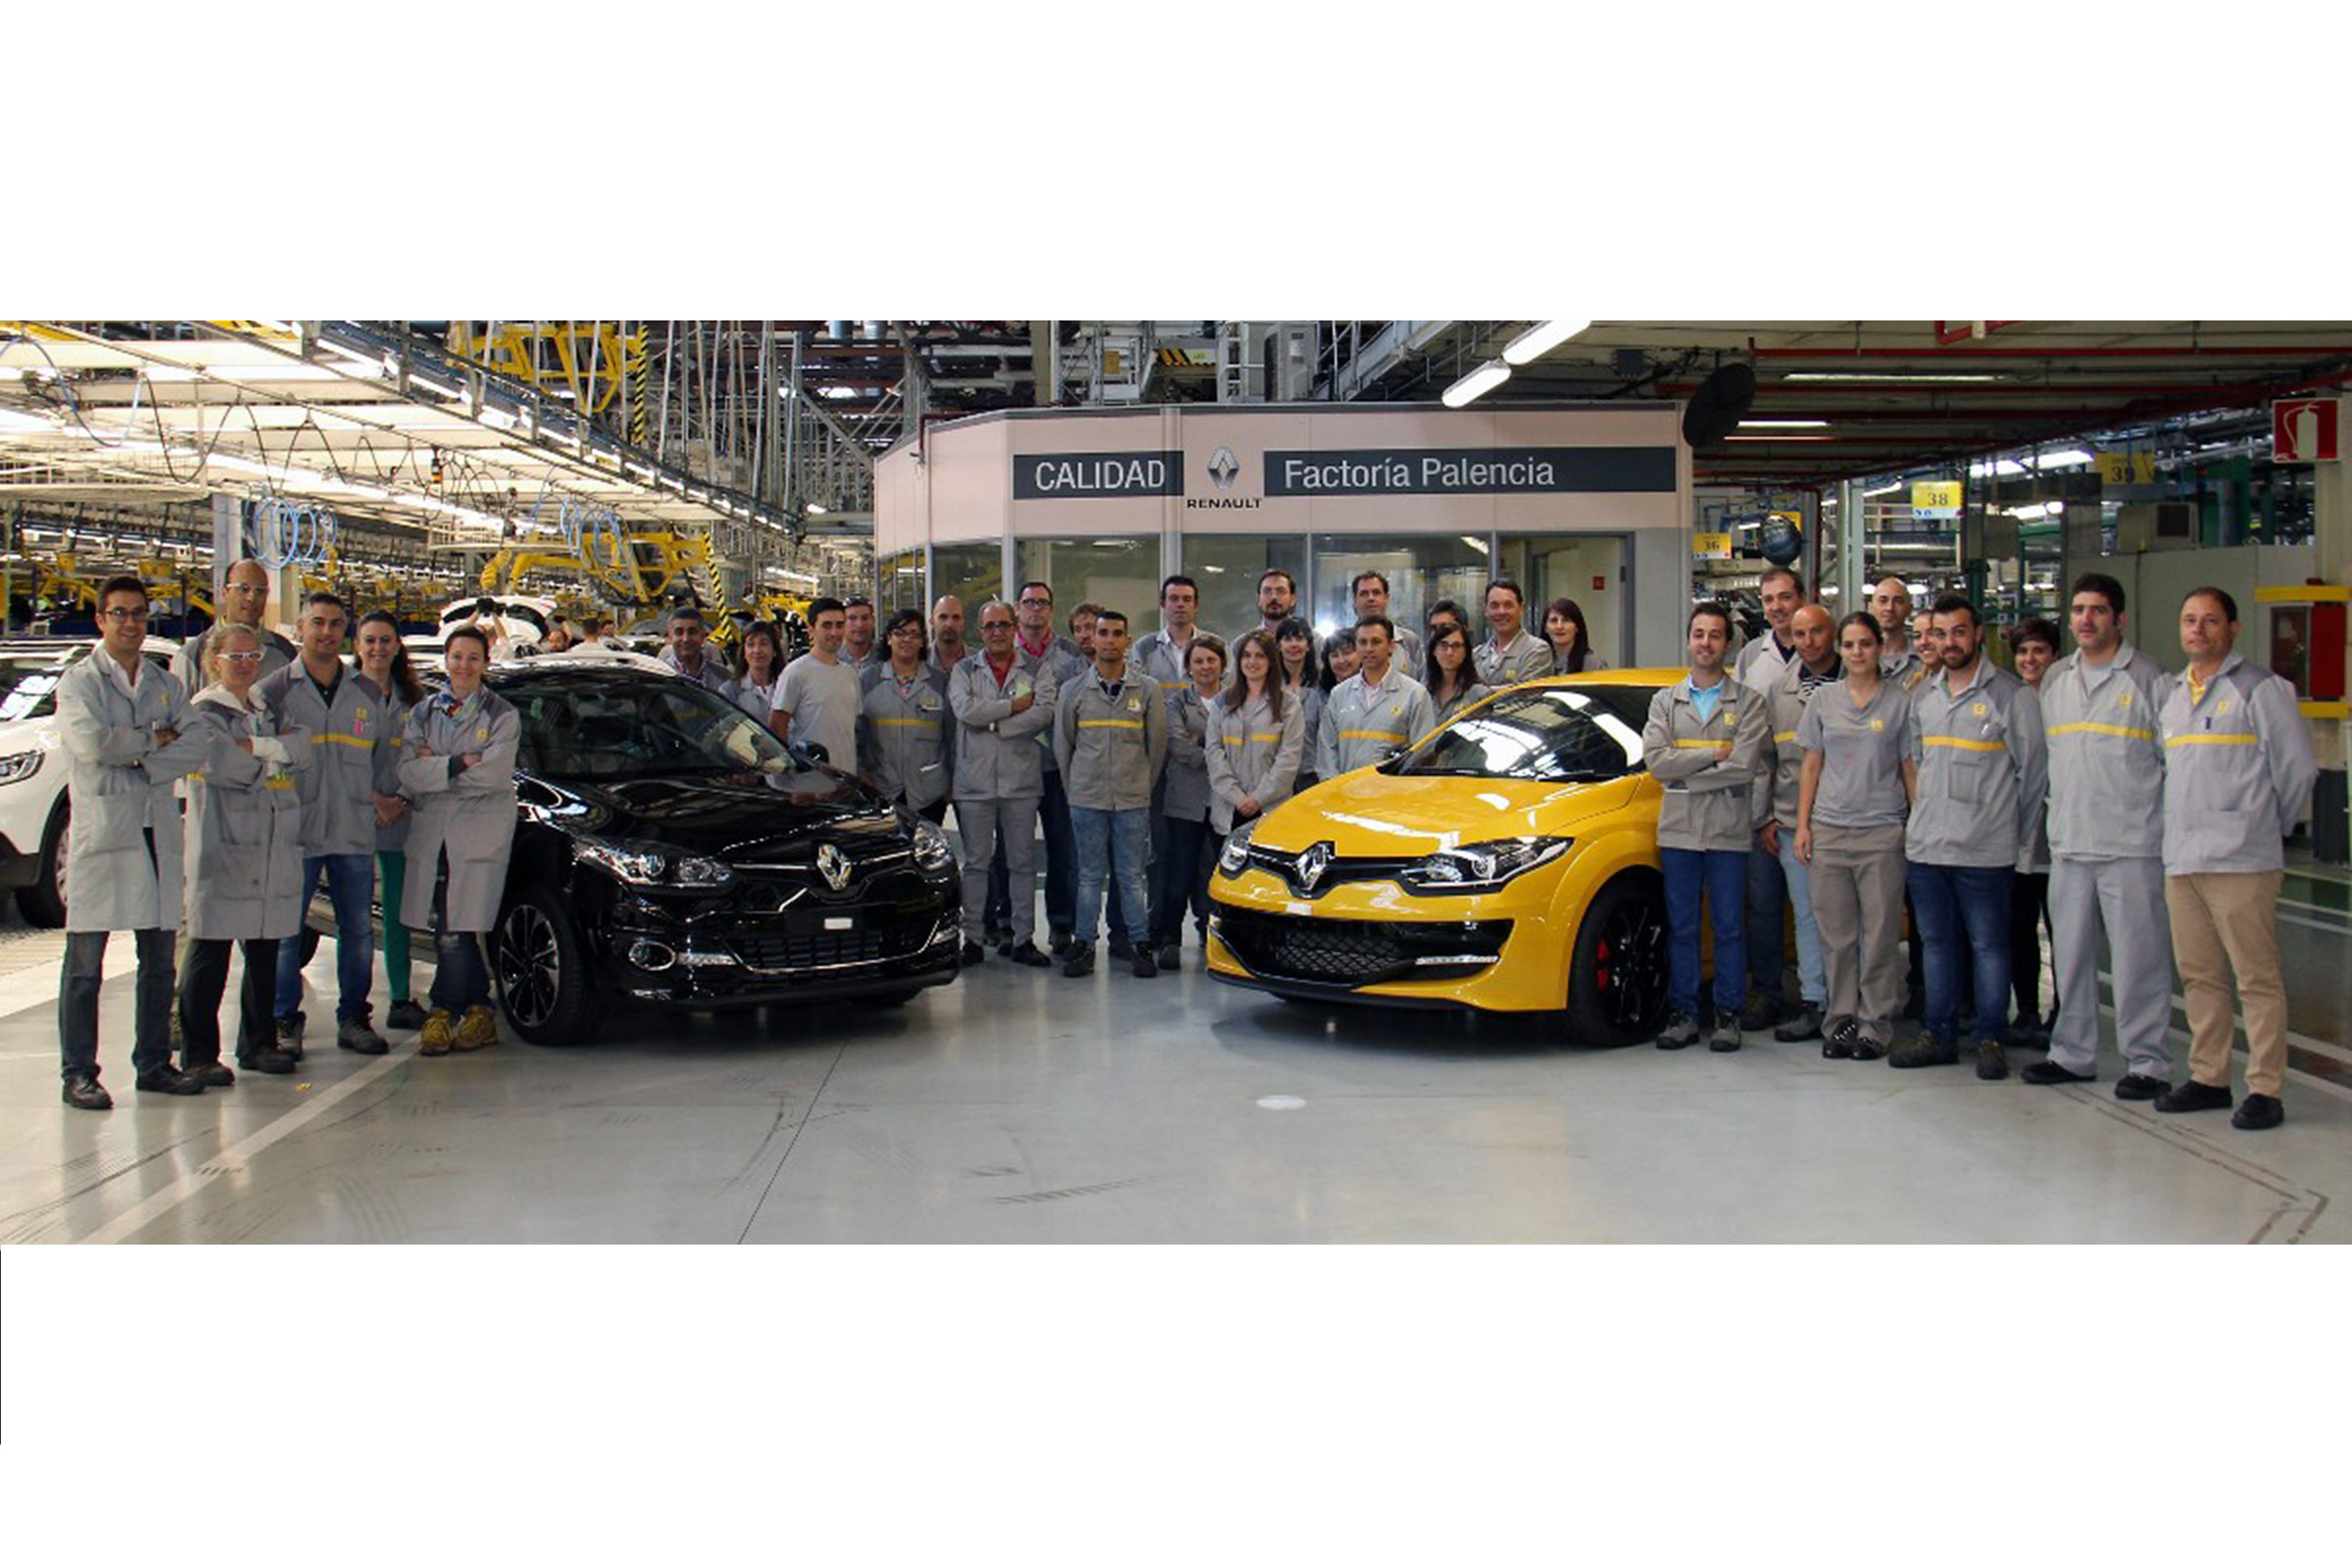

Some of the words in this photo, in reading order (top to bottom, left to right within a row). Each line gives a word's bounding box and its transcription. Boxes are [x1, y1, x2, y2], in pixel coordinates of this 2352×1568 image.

[1035, 460, 1165, 490] CALIDAD
[1285, 457, 1410, 489] Factoría
[1422, 457, 1555, 487] Palencia
[1187, 498, 1262, 509] RENAULT
[1928, 491, 1948, 506] 38
